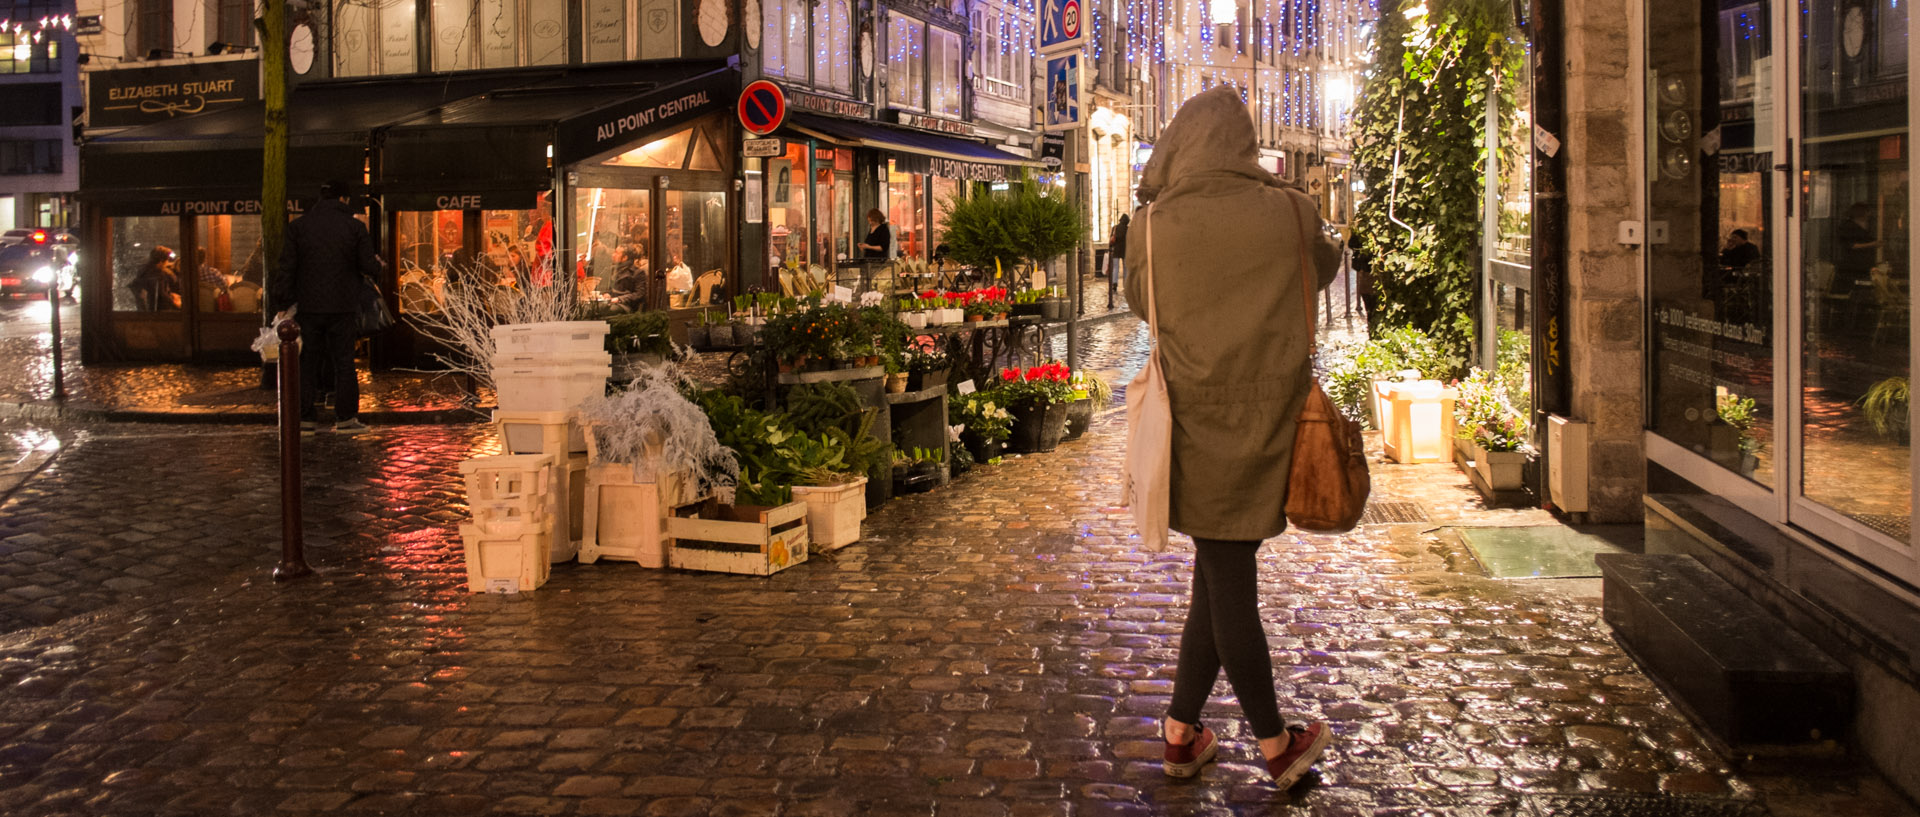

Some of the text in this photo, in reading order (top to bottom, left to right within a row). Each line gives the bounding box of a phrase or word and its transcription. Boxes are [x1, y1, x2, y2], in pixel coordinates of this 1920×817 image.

[1066, 12, 1077, 26] 20
[109, 79, 235, 101] ELIZABETH STUART
[597, 90, 711, 142] AU POINT CENTRAL
[803, 95, 832, 113] POINT
[833, 101, 865, 117] CENTRAL
[930, 157, 1005, 183] AU POINT CENTRAL
[160, 199, 305, 215] AU POINT CENAL
[436, 195, 482, 209] CAFE
[1660, 306, 1669, 324] de
[1669, 307, 1684, 328] 1000
[1723, 320, 1743, 341] dans
